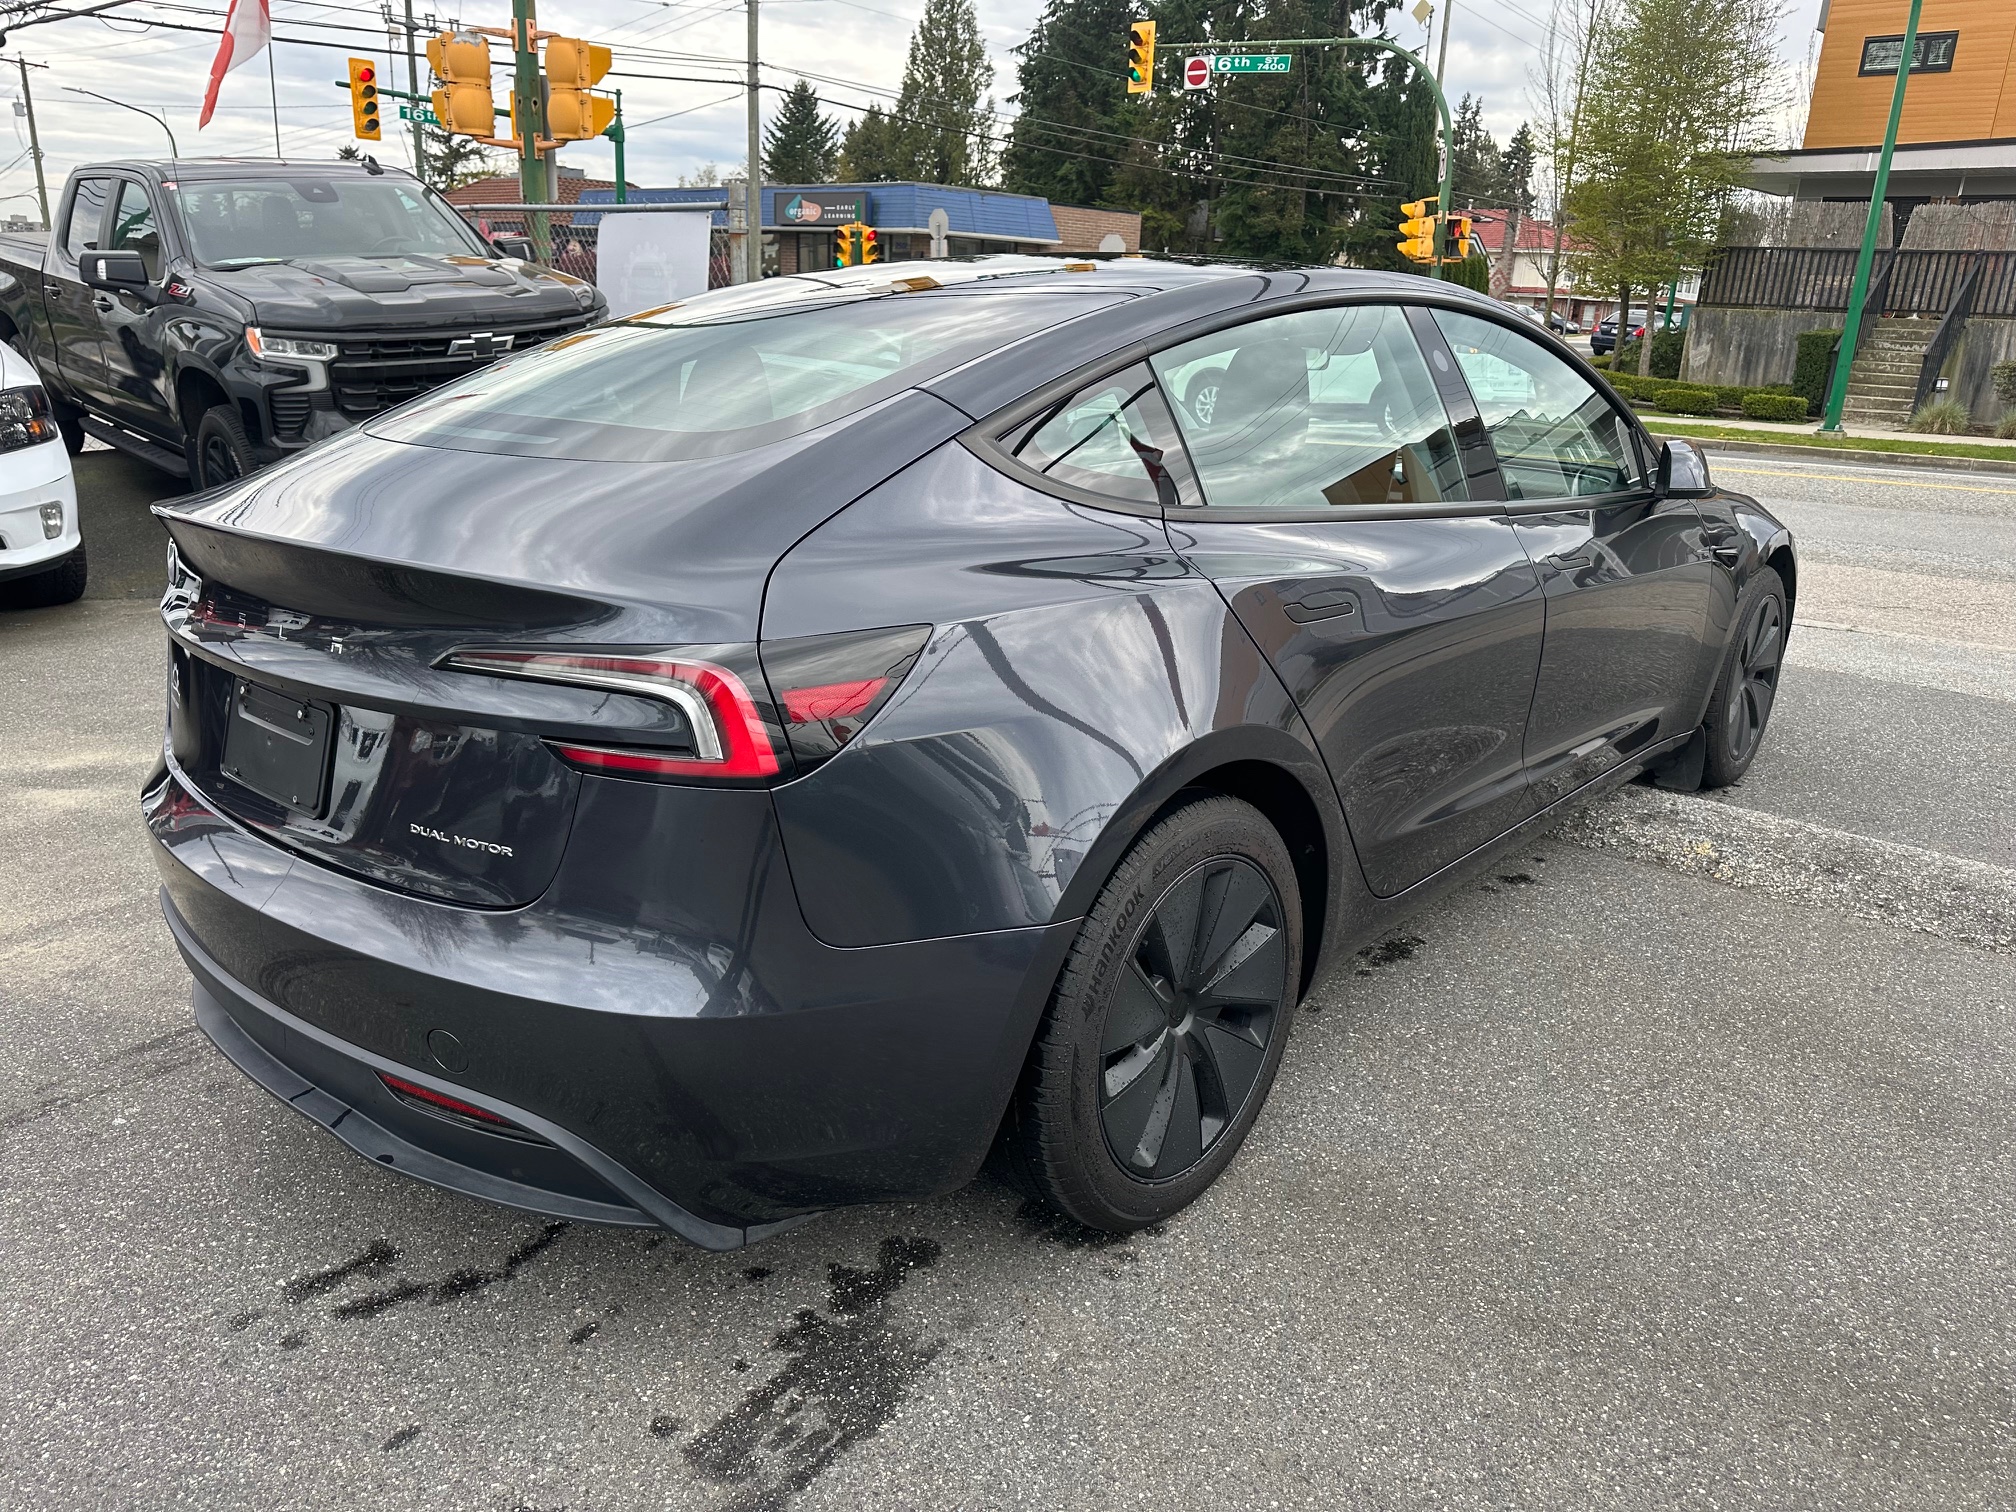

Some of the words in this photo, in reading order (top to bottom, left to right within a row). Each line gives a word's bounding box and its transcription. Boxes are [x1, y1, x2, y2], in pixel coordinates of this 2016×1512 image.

[1218, 57, 1250, 71] 6th
[1257, 63, 1285, 71] 7400
[789, 205, 817, 218] organic
[410, 823, 450, 843] DUAL
[453, 835, 513, 857] MOTOR
